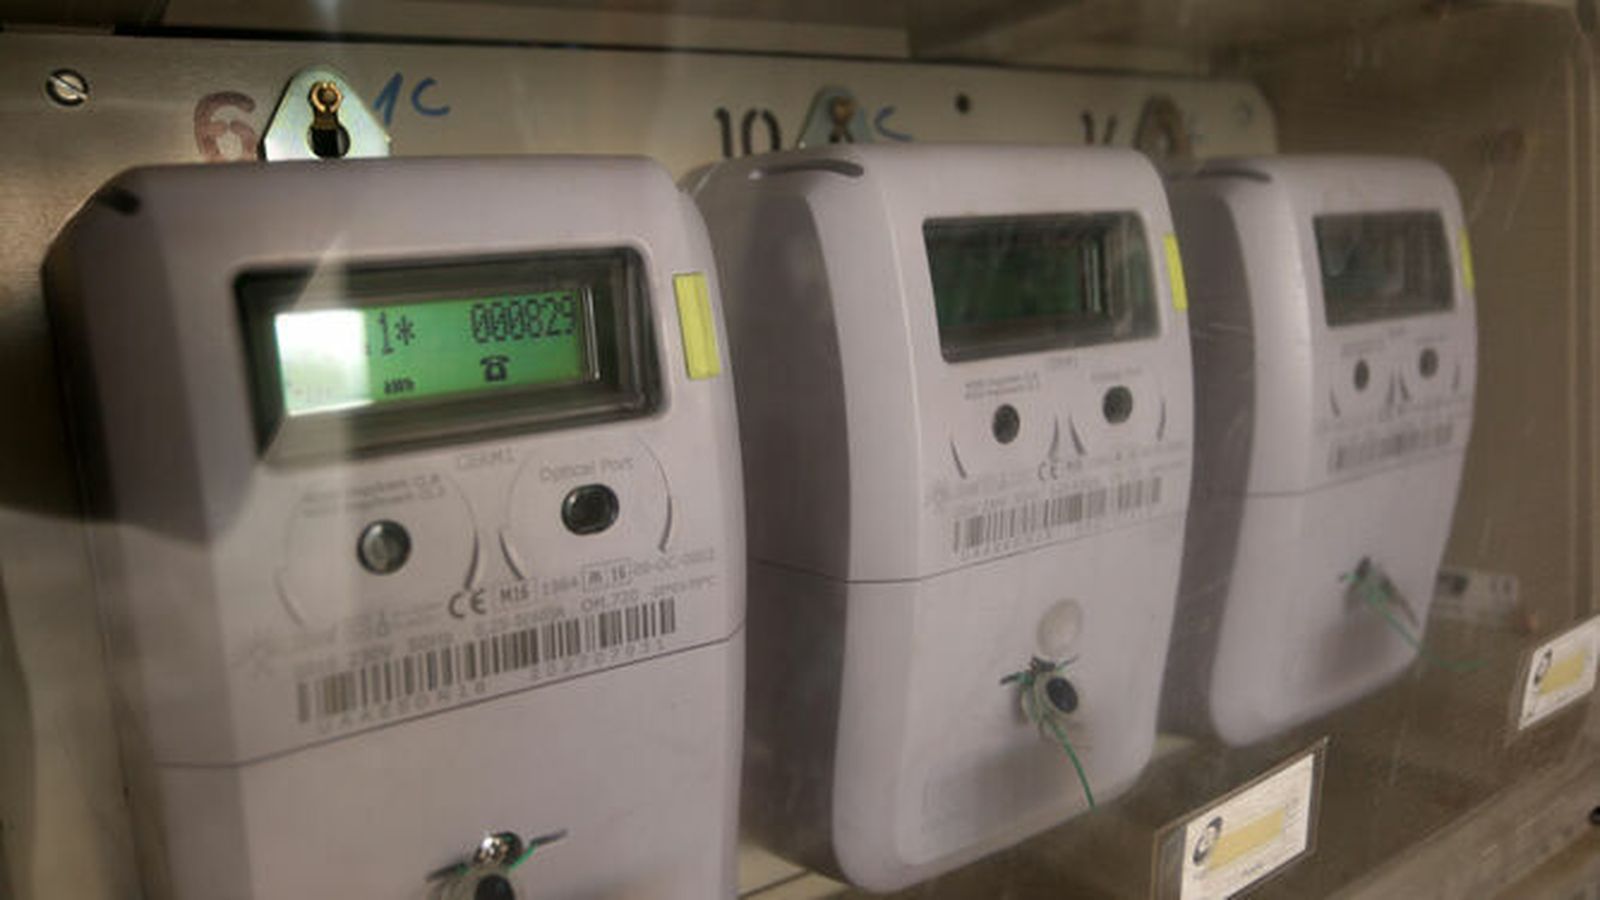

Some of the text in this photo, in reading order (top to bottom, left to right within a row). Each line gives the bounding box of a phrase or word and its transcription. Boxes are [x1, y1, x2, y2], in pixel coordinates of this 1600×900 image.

[714, 107, 781, 158] 10
[470, 295, 578, 343] 000829
[448, 588, 488, 619] CE
